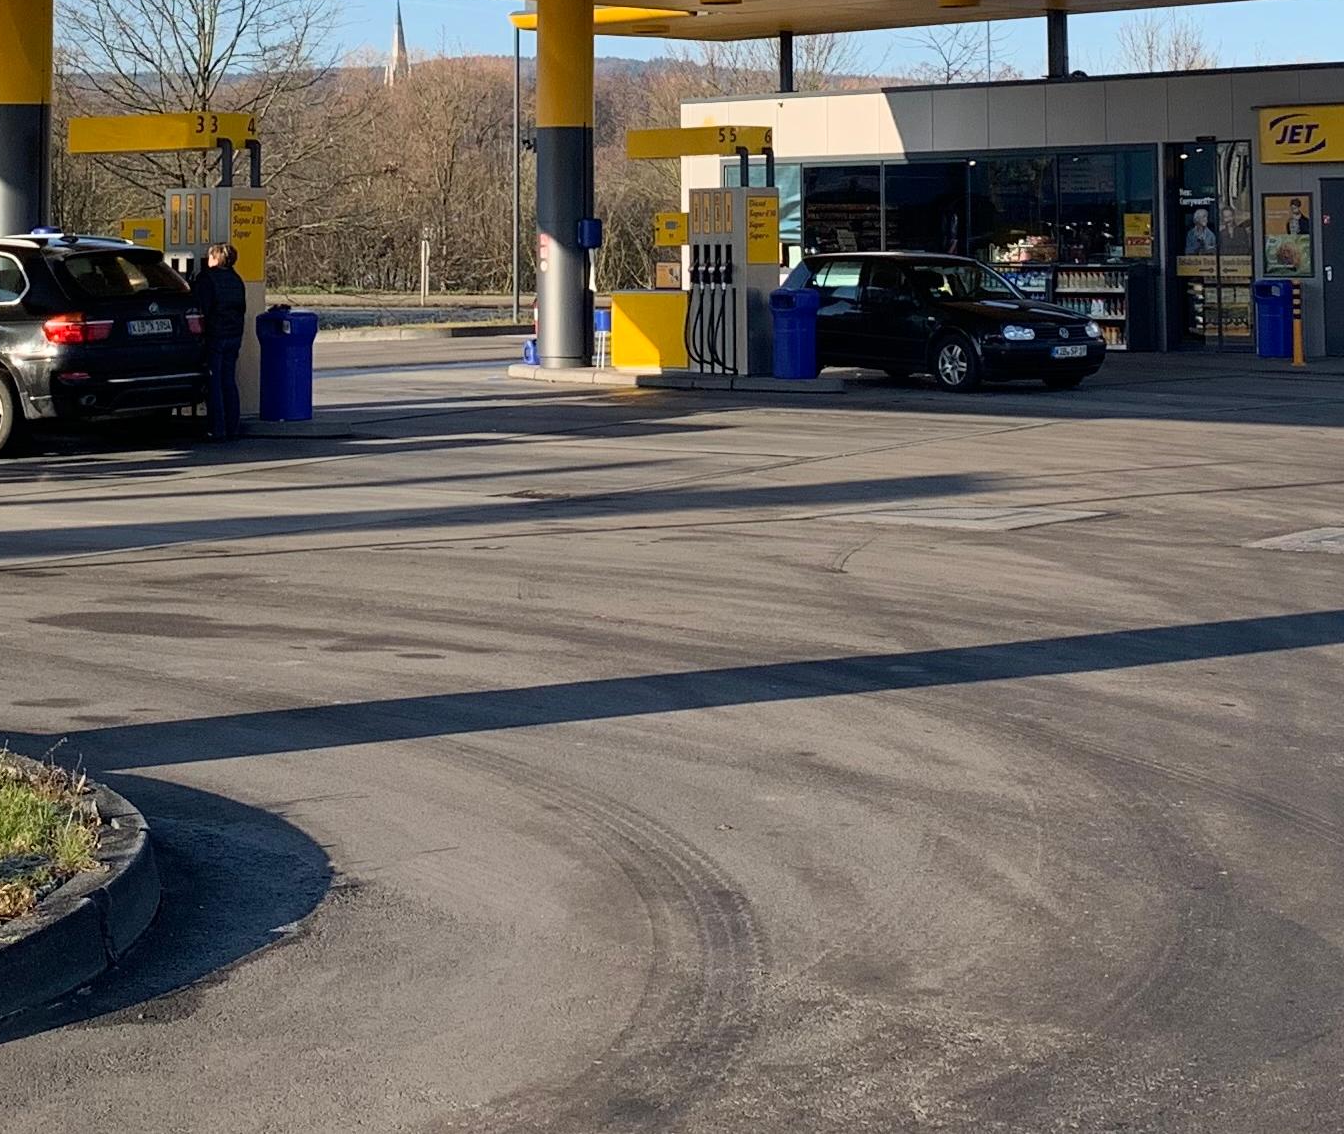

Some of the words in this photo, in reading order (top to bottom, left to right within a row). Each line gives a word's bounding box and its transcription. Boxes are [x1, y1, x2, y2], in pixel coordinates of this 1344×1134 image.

[195, 116, 205, 133] 3
[210, 115, 218, 133] 3
[247, 117, 256, 135] 4
[718, 127, 726, 143] 5
[729, 127, 737, 143] 5
[764, 129, 772, 144] 6
[1275, 123, 1320, 145] JET
